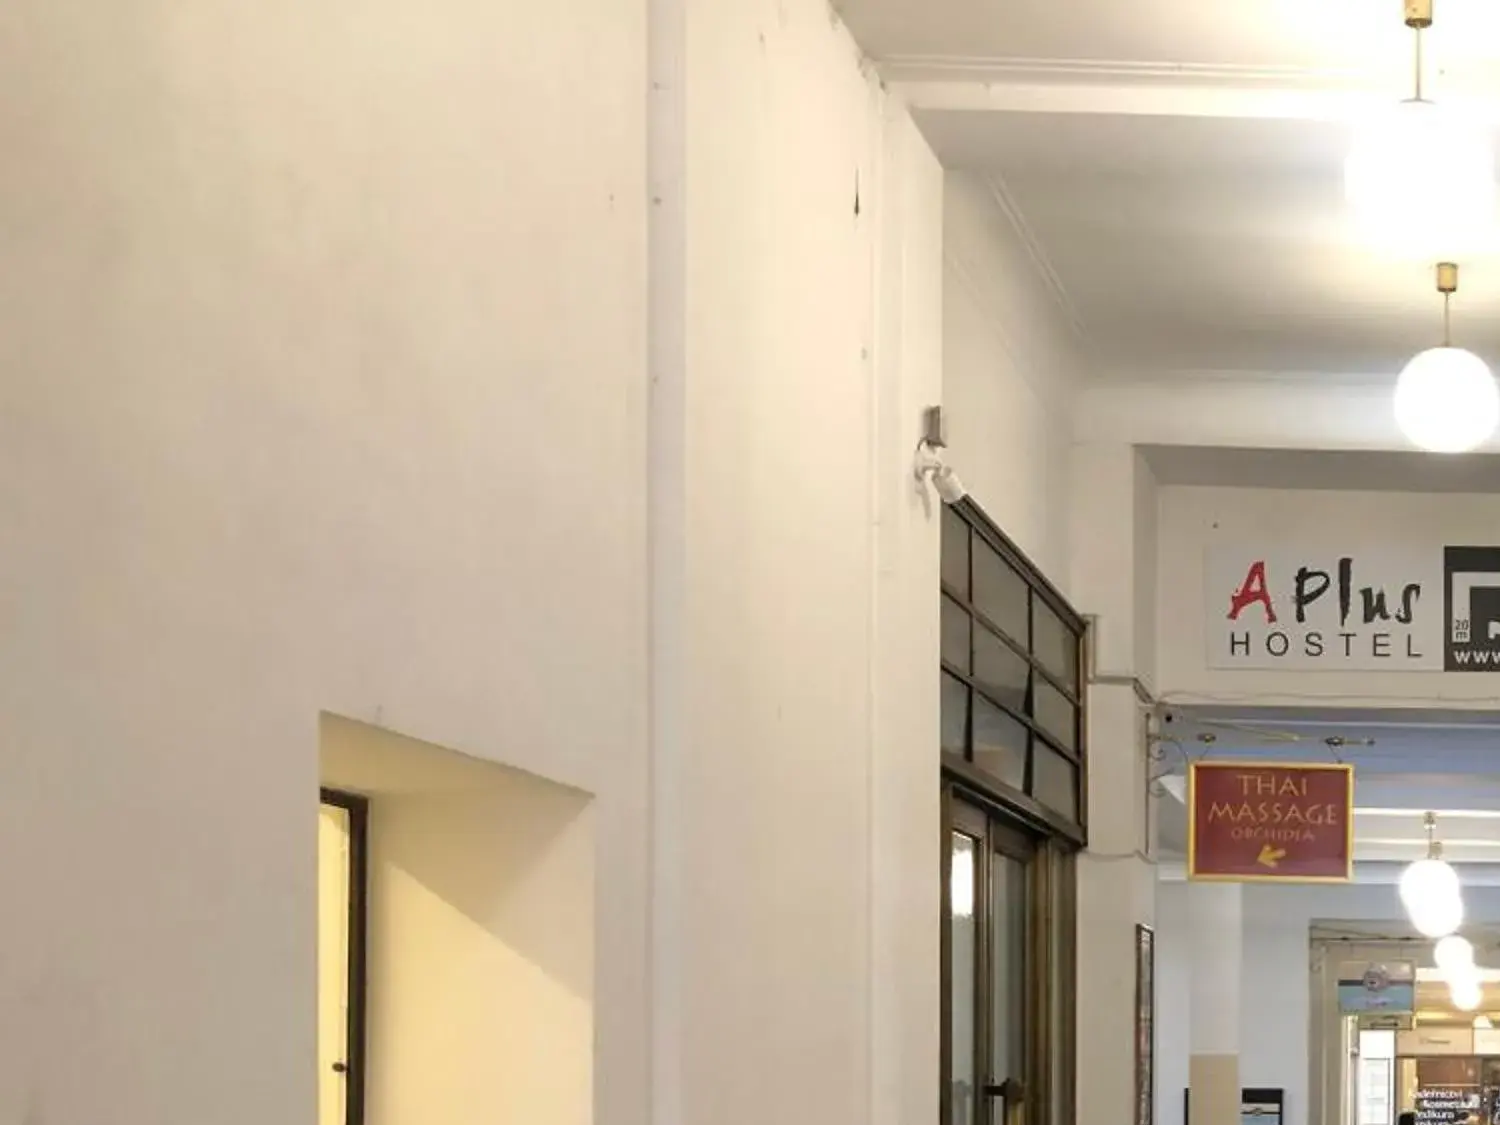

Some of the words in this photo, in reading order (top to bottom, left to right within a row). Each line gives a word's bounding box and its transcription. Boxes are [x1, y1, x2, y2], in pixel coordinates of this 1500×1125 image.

[1231, 631, 1423, 657] HOSTEL
[1236, 774, 1308, 797] THAI
[1208, 801, 1337, 825] MASSAGE
